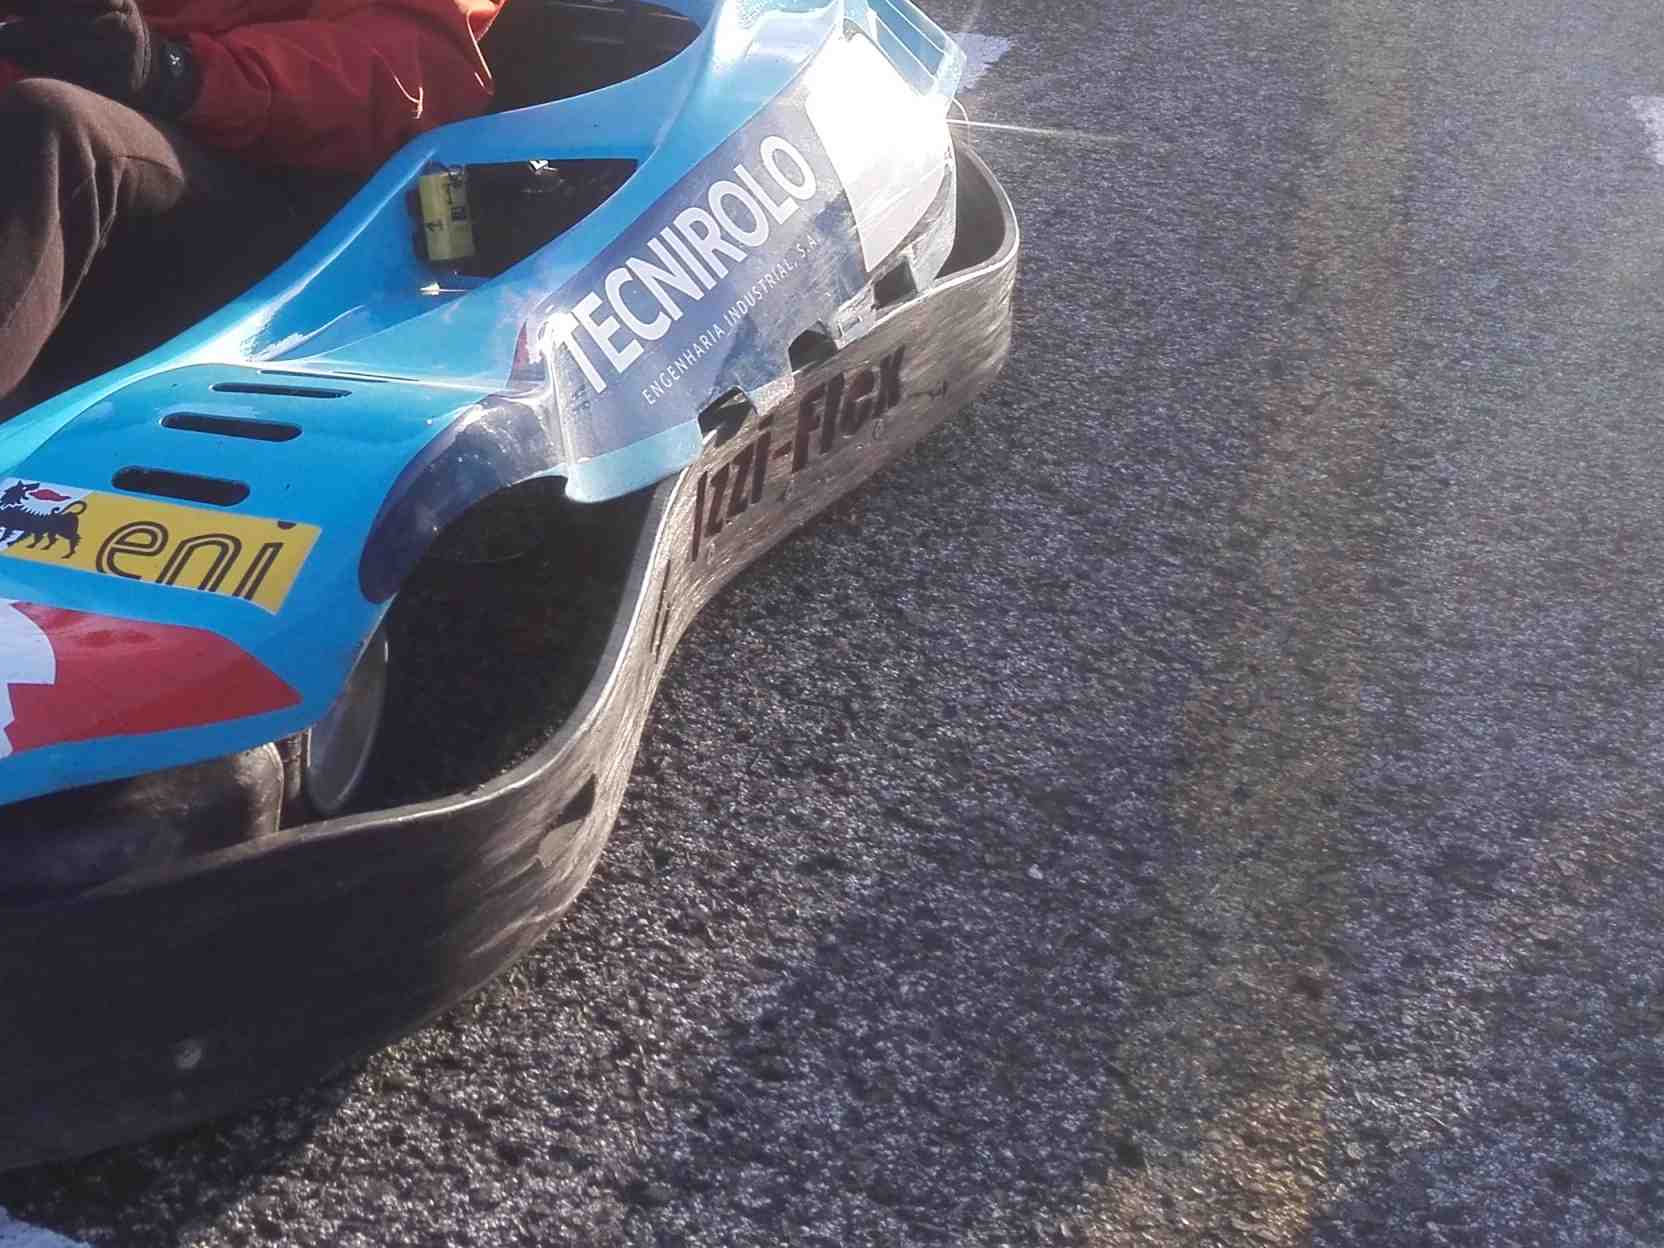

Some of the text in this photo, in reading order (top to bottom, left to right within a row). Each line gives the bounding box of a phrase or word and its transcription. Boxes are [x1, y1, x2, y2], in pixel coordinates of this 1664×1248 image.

[557, 135, 816, 394] TECNIROLO
[642, 323, 726, 405] ENGENHARIA
[96, 520, 297, 601] eni
